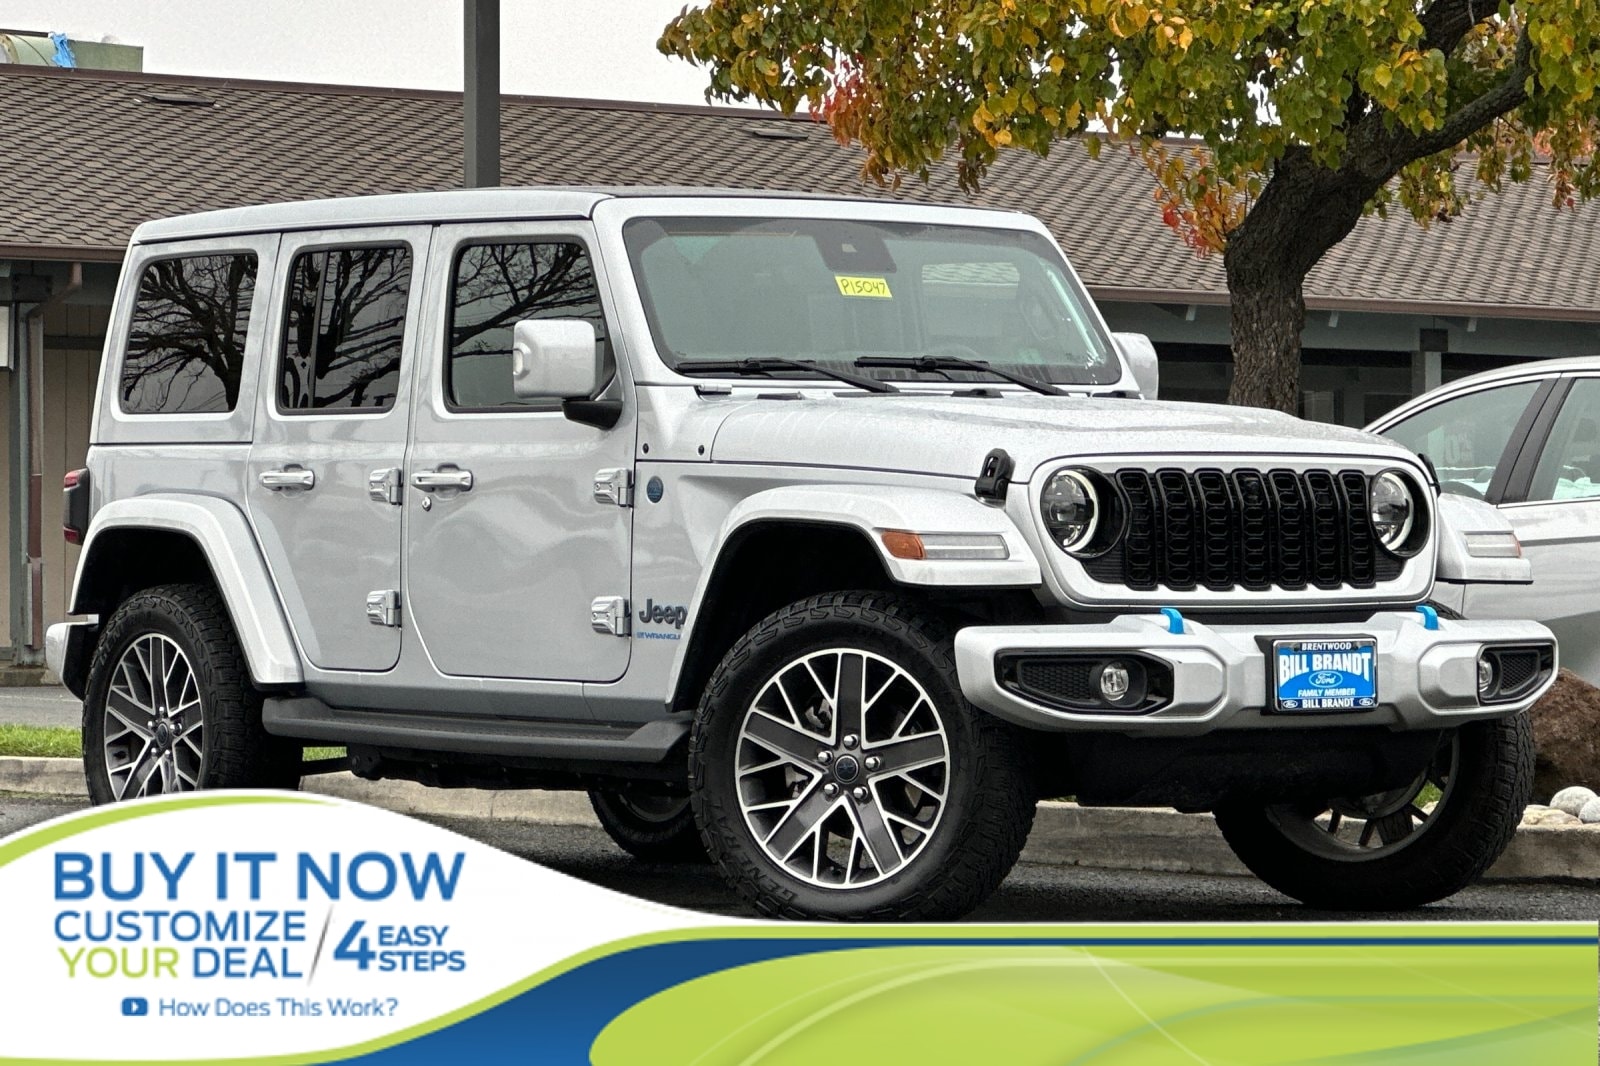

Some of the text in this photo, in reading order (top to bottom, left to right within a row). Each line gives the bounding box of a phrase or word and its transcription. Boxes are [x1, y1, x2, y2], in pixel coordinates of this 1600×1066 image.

[840, 278, 886, 295] P15047
[638, 598, 688, 630] Jeep
[1301, 642, 1352, 651] BRENTWOOD
[1279, 652, 1371, 687] BILL BRANDT
[1297, 688, 1356, 697] FAMILY MEMBER
[1302, 699, 1320, 709] BILL
[1321, 698, 1354, 708] BRANDT
